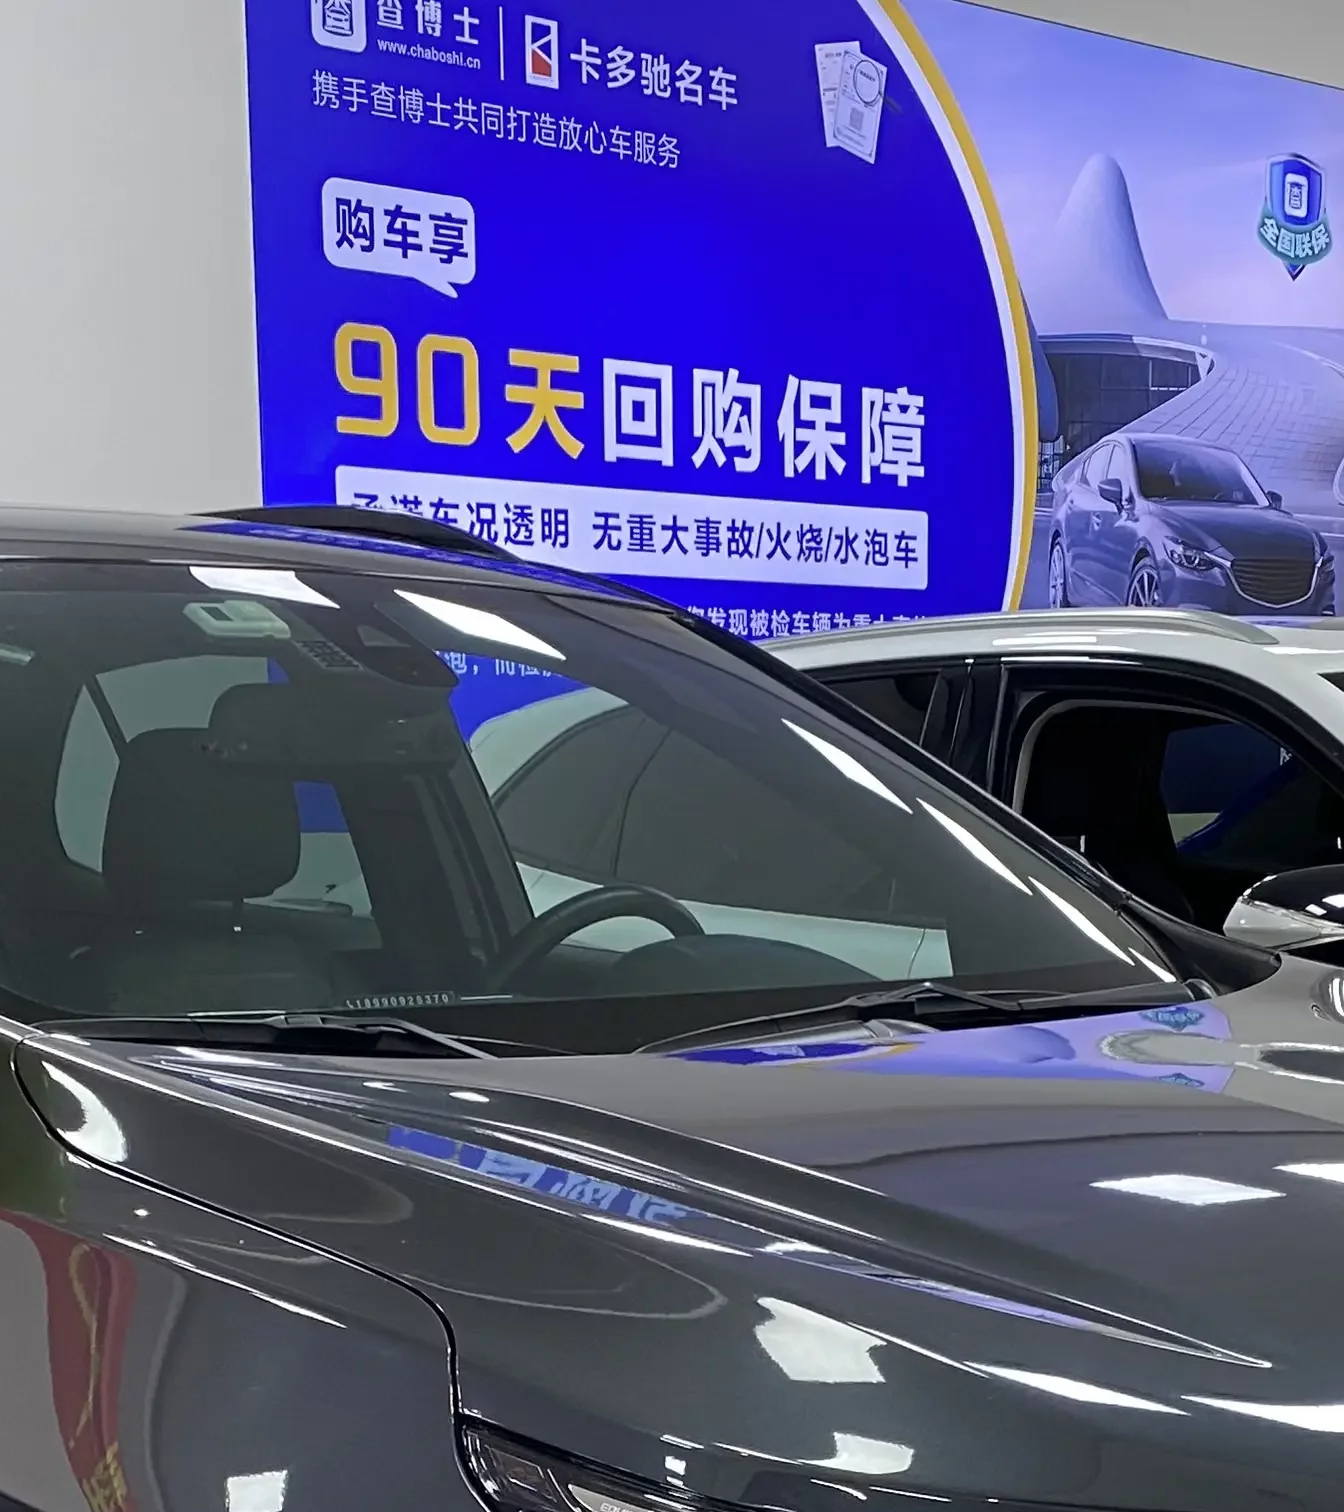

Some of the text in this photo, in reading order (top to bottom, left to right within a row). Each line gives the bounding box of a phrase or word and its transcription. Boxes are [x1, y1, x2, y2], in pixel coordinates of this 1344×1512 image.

[376, 38, 481, 69] www.chaboshi.cn
[569, 38, 739, 111] 卡多驰名车
[311, 69, 681, 169] 携手查博士共同打造放心车服务
[334, 197, 469, 265] 购车享
[1259, 217, 1330, 258] 全国联保
[333, 322, 927, 488] 90天回购保障
[591, 510, 920, 569] 无重大事故/火烧/水泡车
